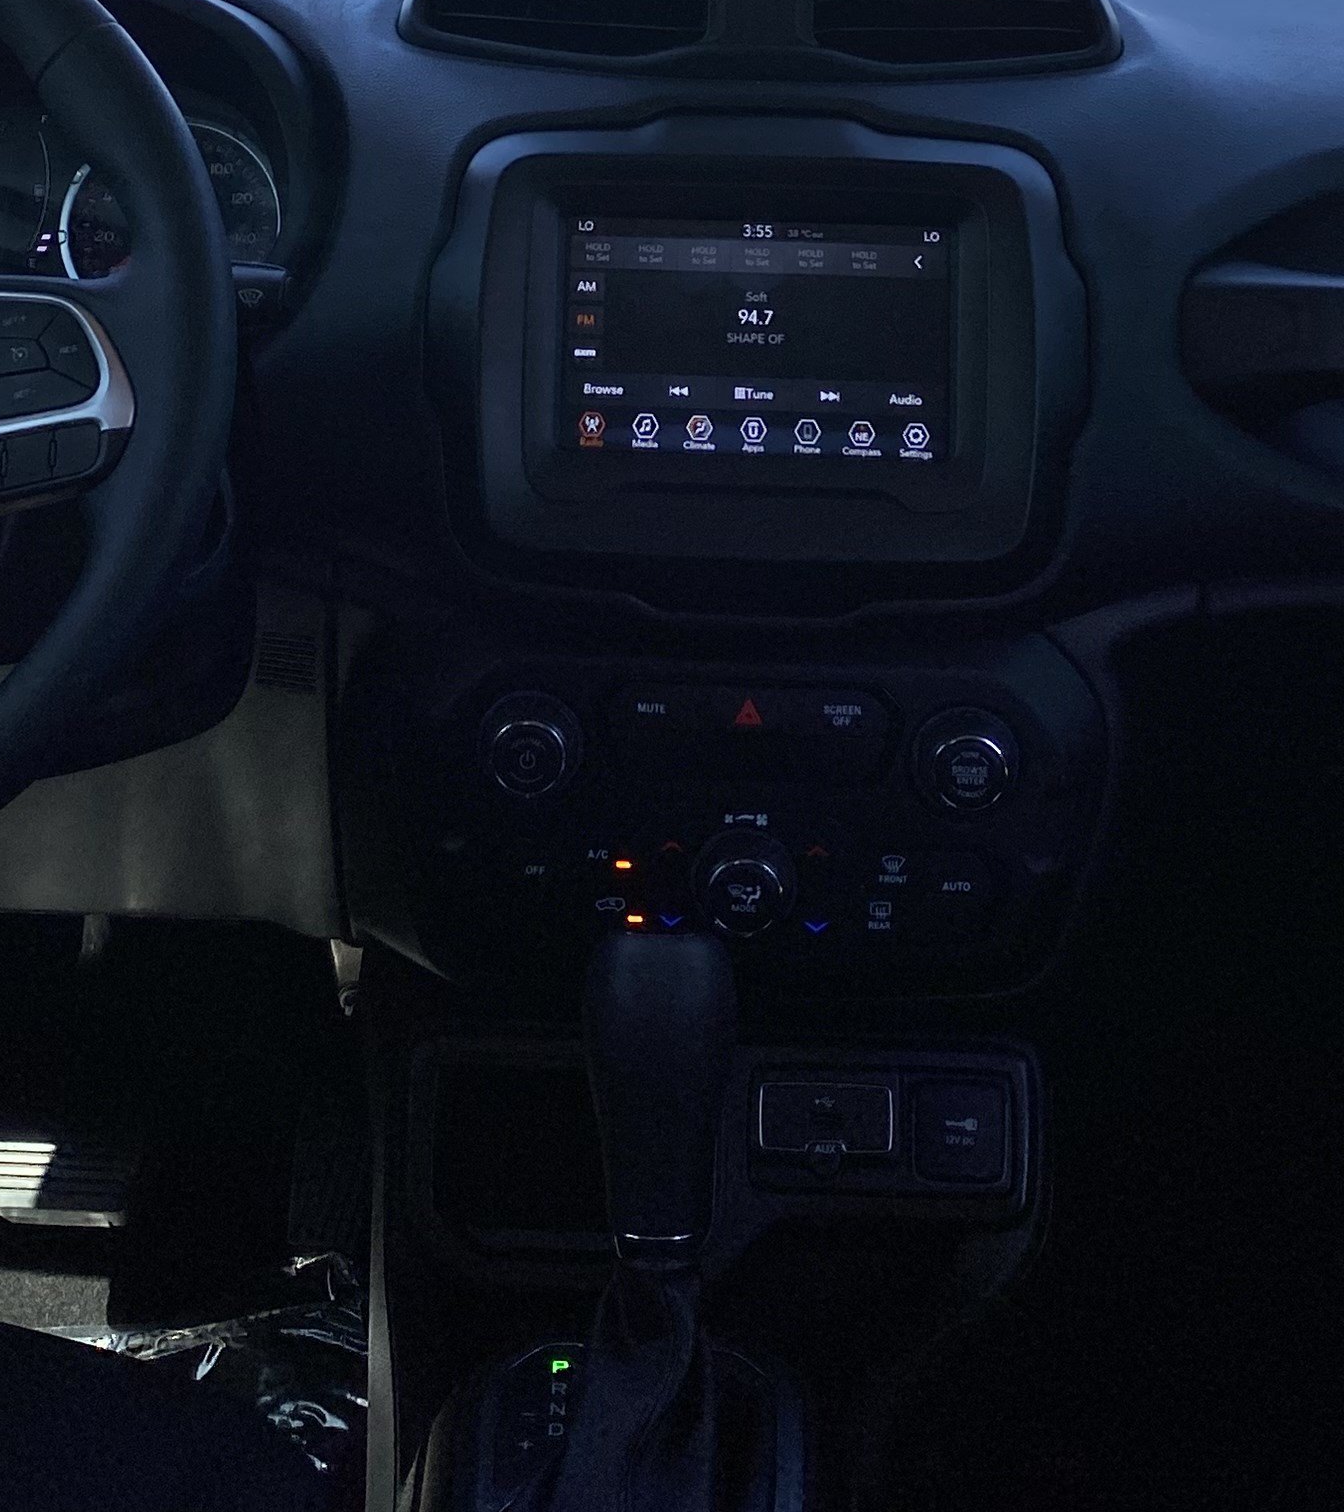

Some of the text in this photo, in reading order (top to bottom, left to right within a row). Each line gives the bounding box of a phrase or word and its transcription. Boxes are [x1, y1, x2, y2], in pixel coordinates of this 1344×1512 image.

[578, 220, 595, 232] LO
[742, 223, 774, 238] 3:55
[94, 231, 115, 243] 20
[923, 231, 941, 243] LO
[585, 242, 611, 252] HOLD
[638, 244, 664, 254] HOLD
[691, 246, 717, 256] HOLD
[744, 248, 770, 257] HOLD
[798, 249, 824, 258] HOLD
[851, 251, 878, 260] HOLD
[576, 281, 597, 293] AM
[745, 291, 768, 303] Soft
[576, 314, 595, 326] FM
[737, 309, 774, 326] 94.7
[726, 332, 786, 345] SHAPE OF
[583, 382, 624, 396] Browse
[745, 388, 775, 401] Tune
[889, 393, 923, 407] Audio
[854, 431, 869, 442] NE
[632, 439, 659, 450] Media
[683, 440, 716, 452] Climate
[742, 443, 765, 455] Apps
[793, 444, 822, 456] Phone
[842, 446, 882, 459] Compass
[899, 448, 933, 461] Settings
[637, 702, 667, 714] MUTE
[823, 704, 862, 716] SCREEN
[586, 848, 609, 860] A/C
[524, 865, 546, 877] OFF
[878, 874, 908, 884] FRONT
[941, 881, 972, 892] AUTO
[731, 904, 758, 914] MODE
[814, 1143, 837, 1155] AUX
[551, 1360, 570, 1374] P
[551, 1382, 568, 1396] R
[549, 1402, 567, 1416] N
